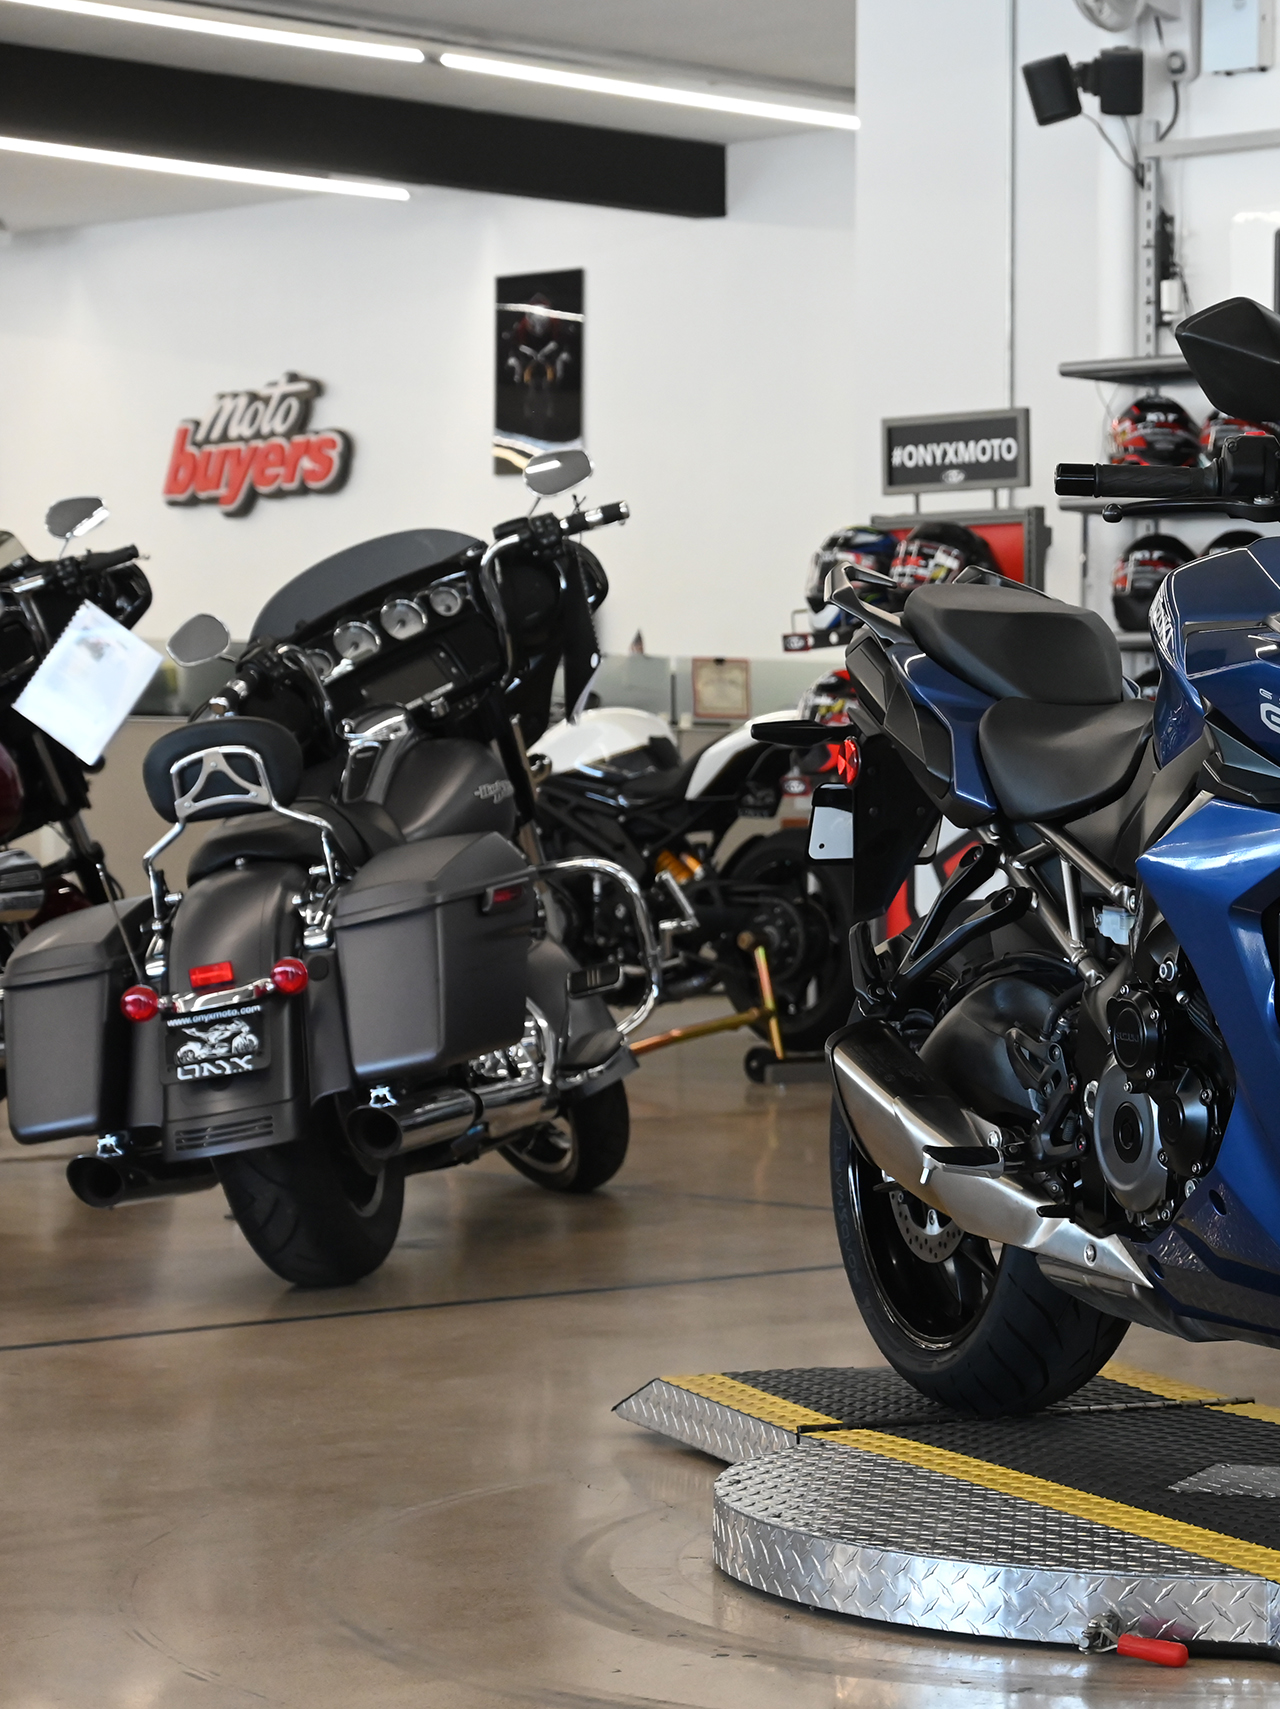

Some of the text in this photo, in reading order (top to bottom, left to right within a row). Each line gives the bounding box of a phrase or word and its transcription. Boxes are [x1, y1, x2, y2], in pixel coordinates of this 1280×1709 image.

[162, 426, 338, 507] buyers
[891, 437, 1019, 468] #ONYXMOTO
[166, 1004, 262, 1027] www.onyxmoto.com
